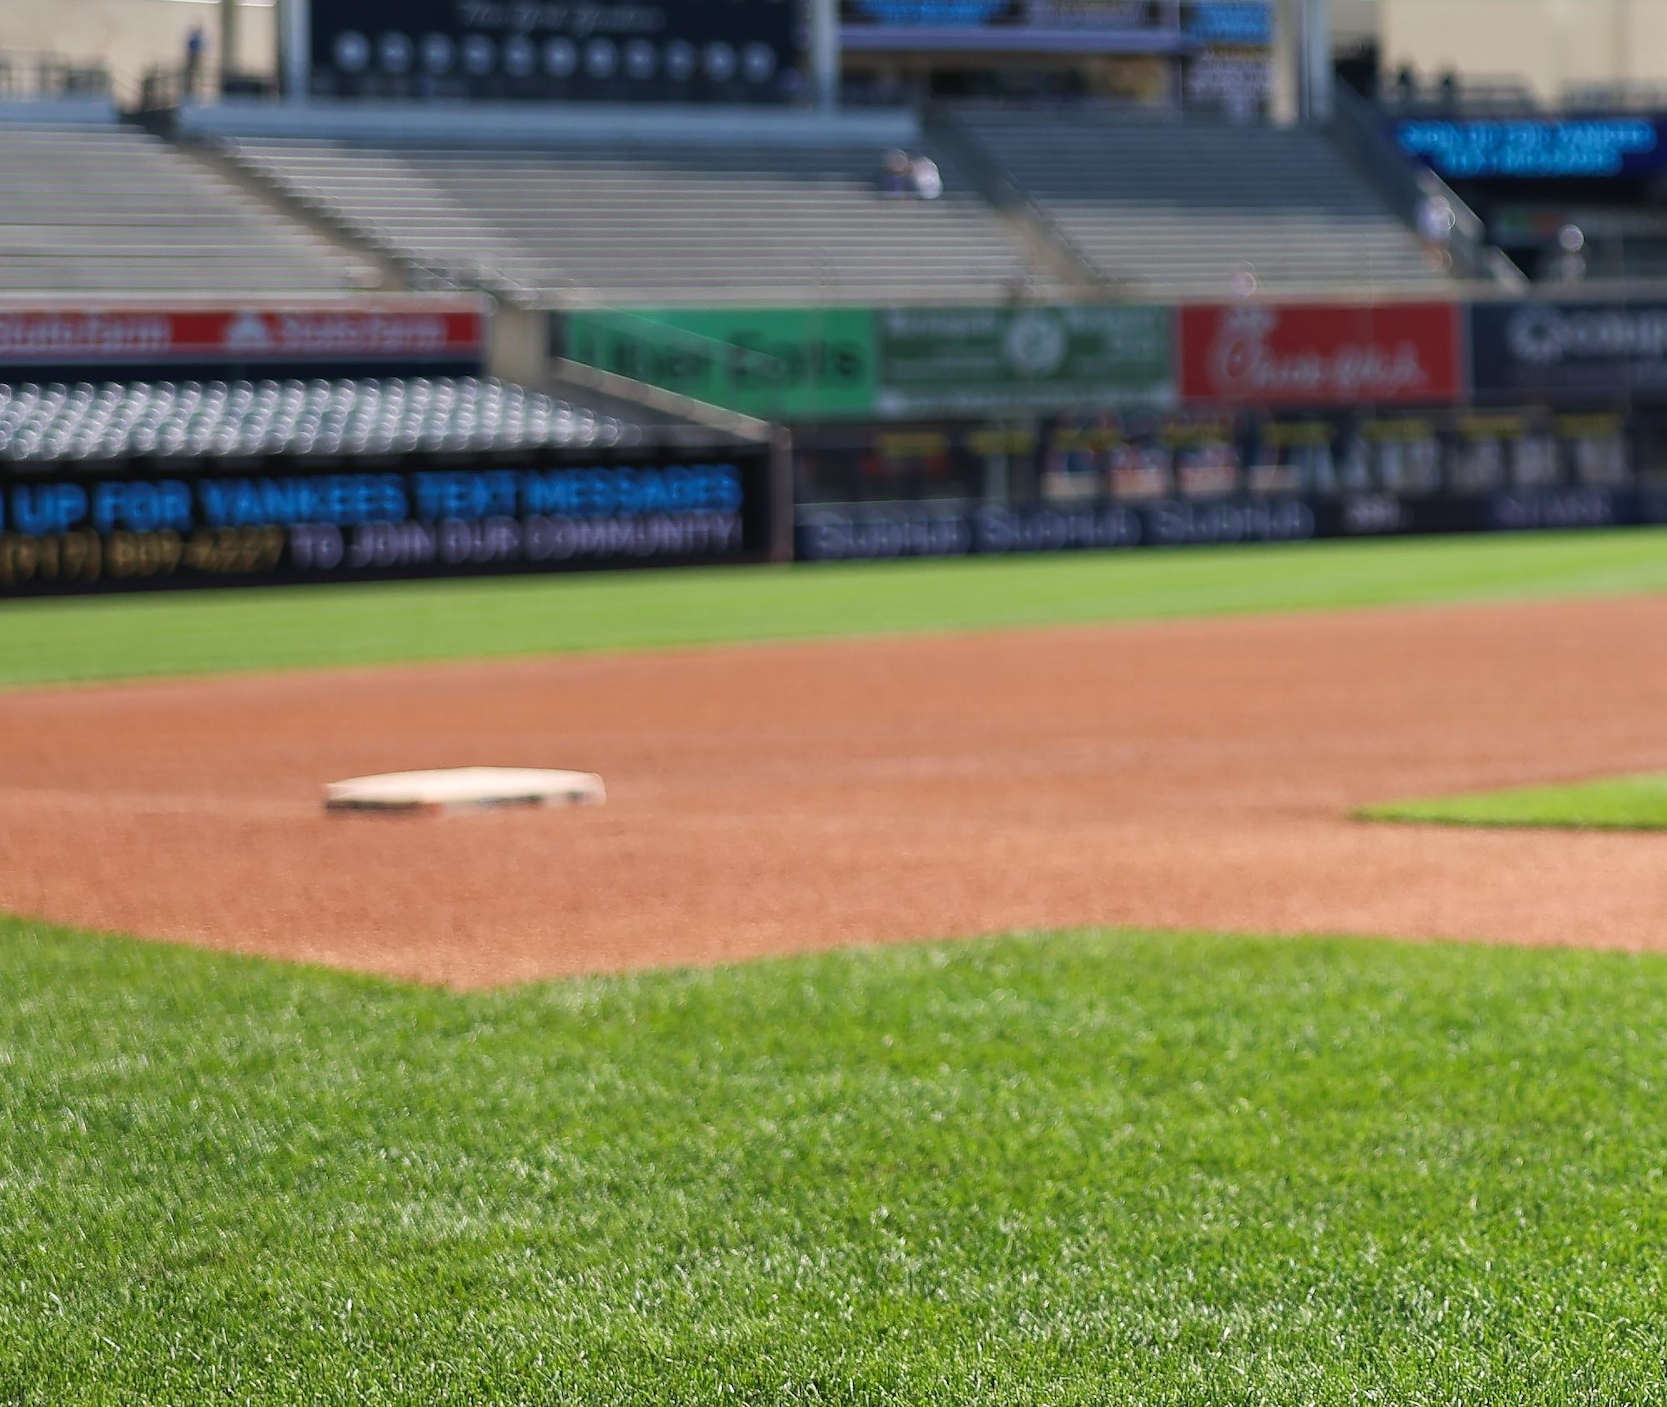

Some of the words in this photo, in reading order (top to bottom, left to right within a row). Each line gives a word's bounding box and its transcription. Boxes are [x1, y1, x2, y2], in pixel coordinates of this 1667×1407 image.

[13, 483, 87, 536] UP
[94, 480, 192, 534] FOR
[200, 473, 406, 528] YANKEES
[413, 470, 518, 519] TEXT
[523, 463, 743, 516] MESSAGES
[349, 520, 436, 569] JOIN
[440, 516, 521, 564] OUR
